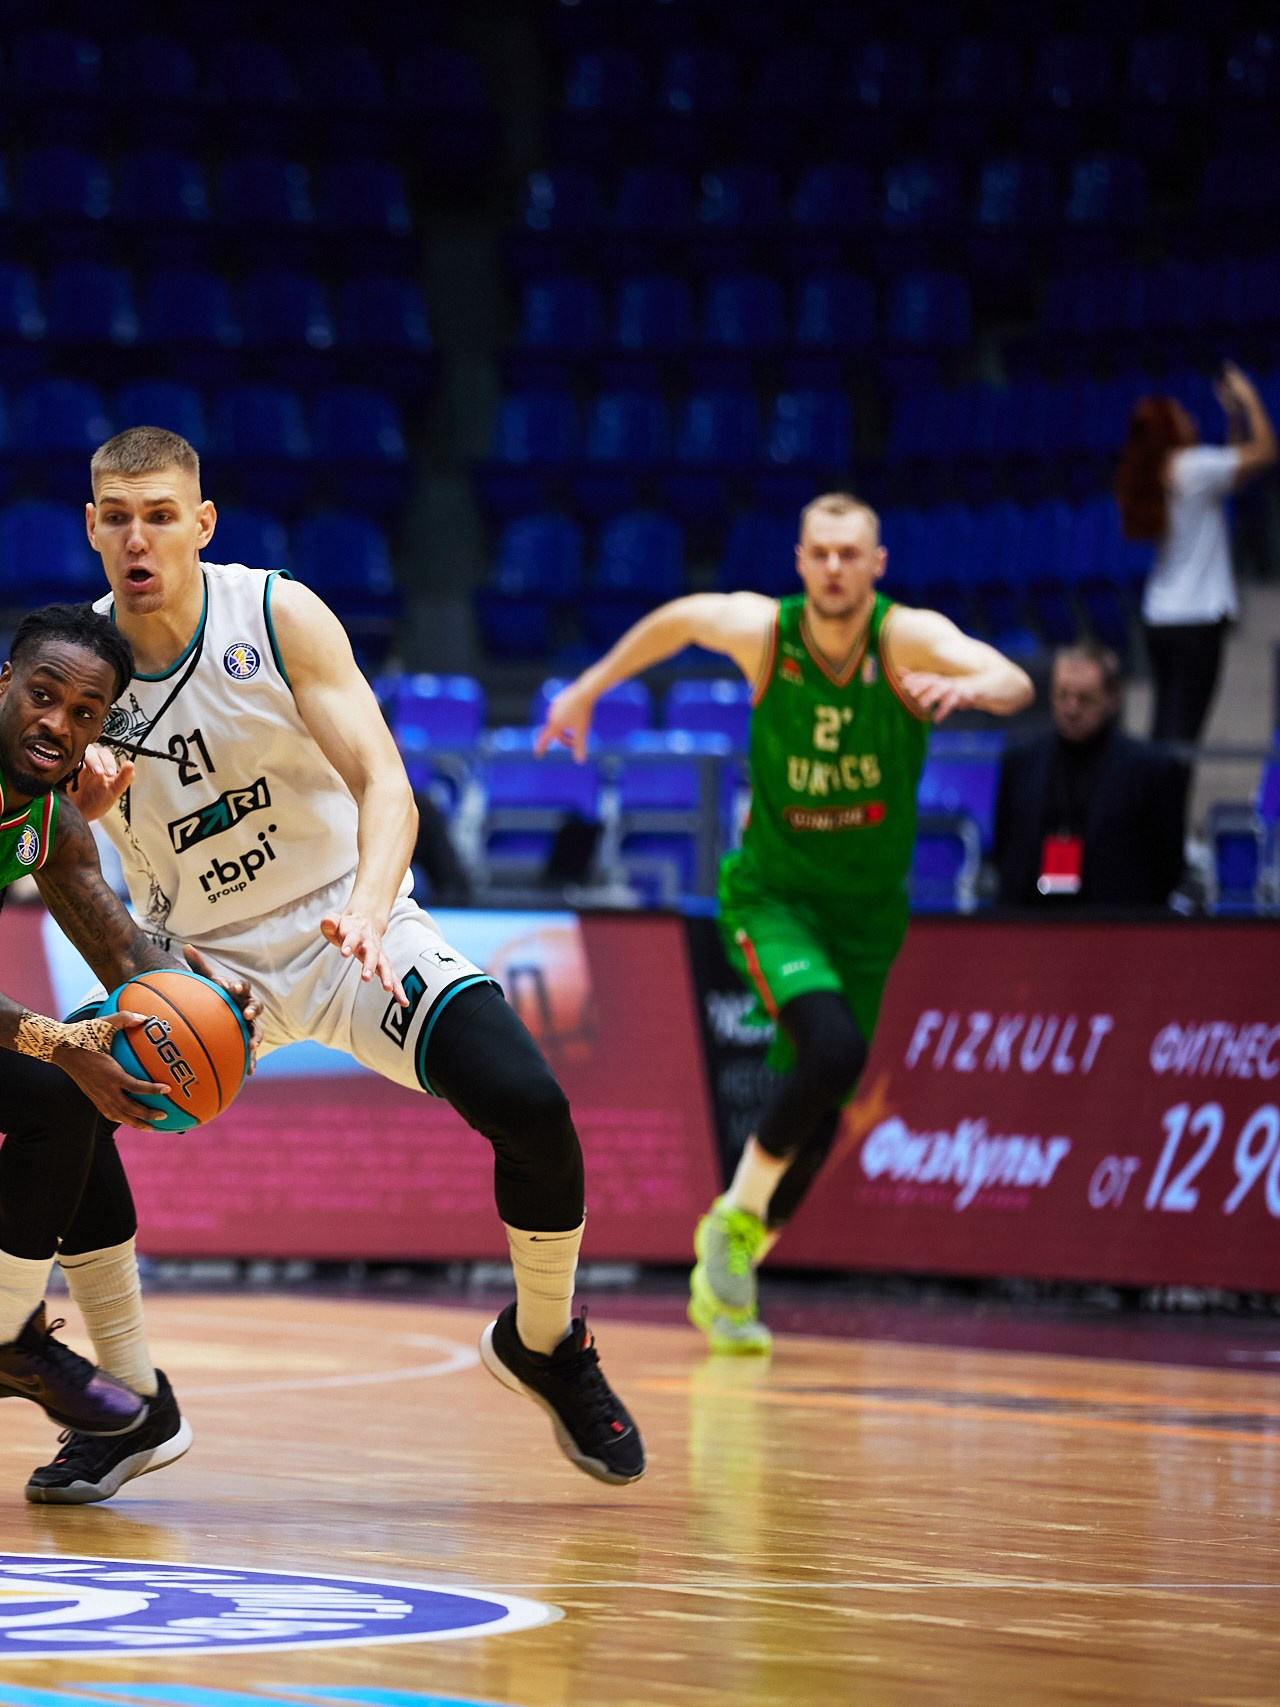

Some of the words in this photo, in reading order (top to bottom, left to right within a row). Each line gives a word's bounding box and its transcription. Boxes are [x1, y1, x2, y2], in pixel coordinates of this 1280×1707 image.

[168, 728, 216, 787] 21
[207, 880, 247, 904] group
[904, 1009, 1114, 1075] FIZKULT
[1144, 1101, 1225, 1212] 12
[1223, 1103, 1280, 1219] 9
